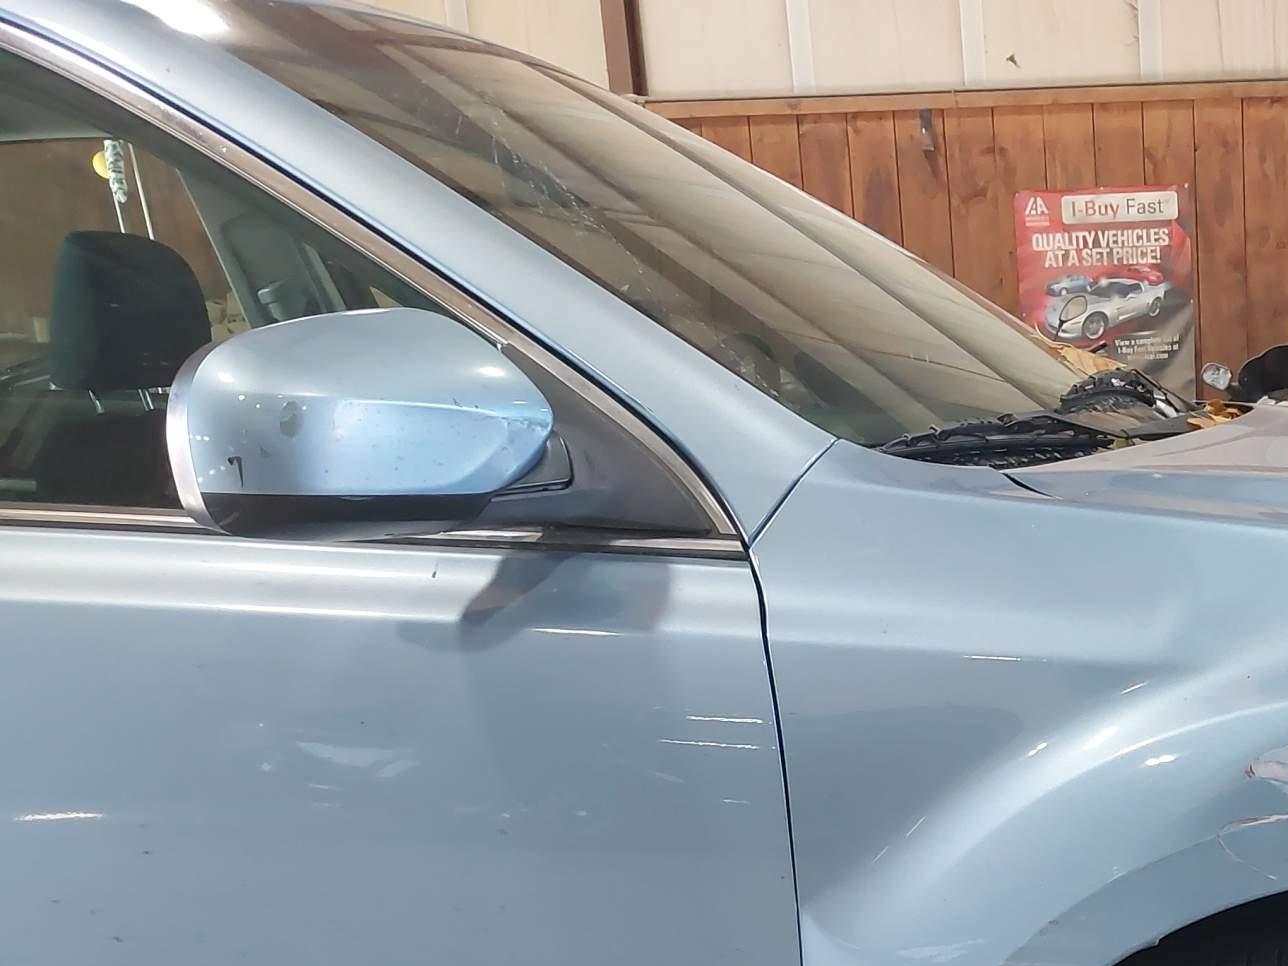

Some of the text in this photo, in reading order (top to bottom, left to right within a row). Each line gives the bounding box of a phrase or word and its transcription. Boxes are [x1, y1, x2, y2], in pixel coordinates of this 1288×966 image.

[1072, 198, 1164, 220] I-Buy Fast
[1032, 228, 1169, 251] QUALITY VEHICLES
[1045, 246, 1160, 268] AT A SET PRICE!
